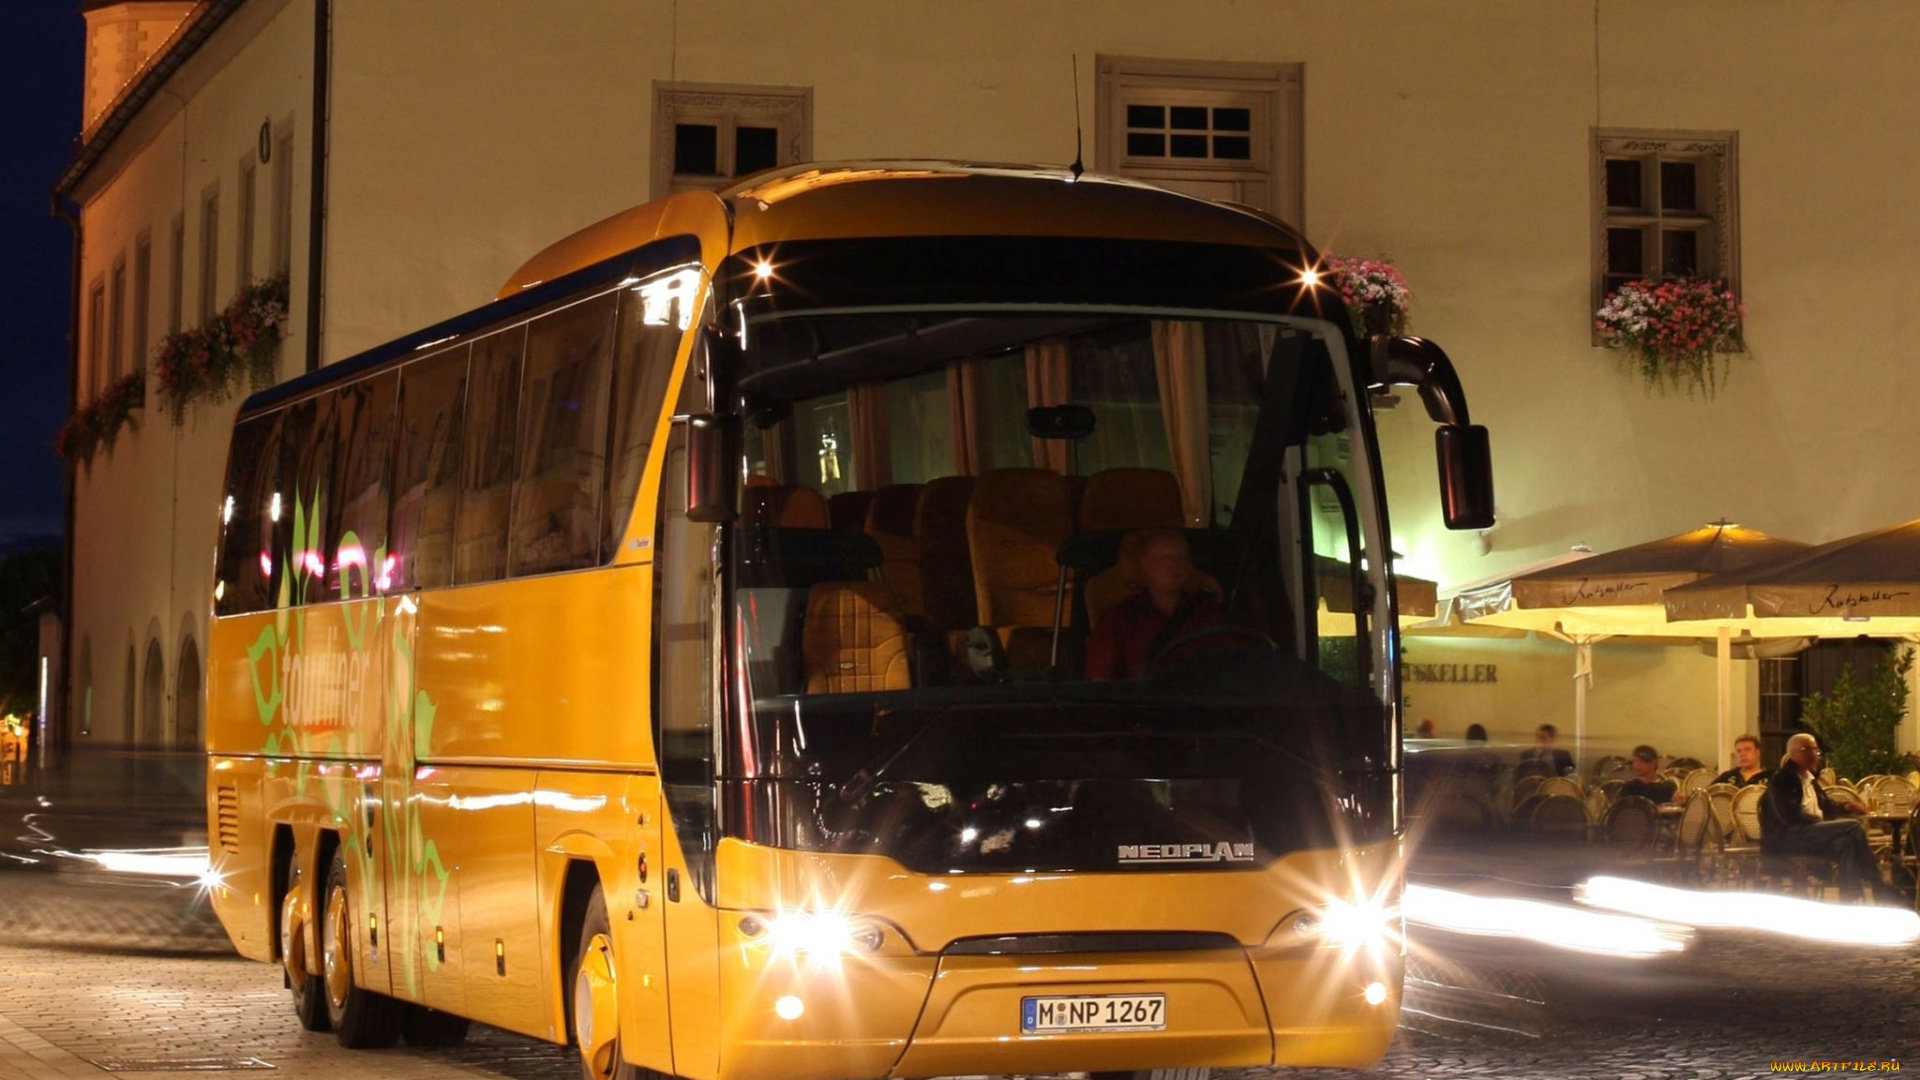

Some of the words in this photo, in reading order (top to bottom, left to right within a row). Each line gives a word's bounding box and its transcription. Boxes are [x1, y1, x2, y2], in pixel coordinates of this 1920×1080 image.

[1809, 584, 1910, 615] Ratskeller
[1118, 841, 1254, 863] NEOPLAN
[1039, 1003, 1053, 1025] M
[1070, 1001, 1099, 1023] NP
[1105, 1000, 1162, 1023] 1267
